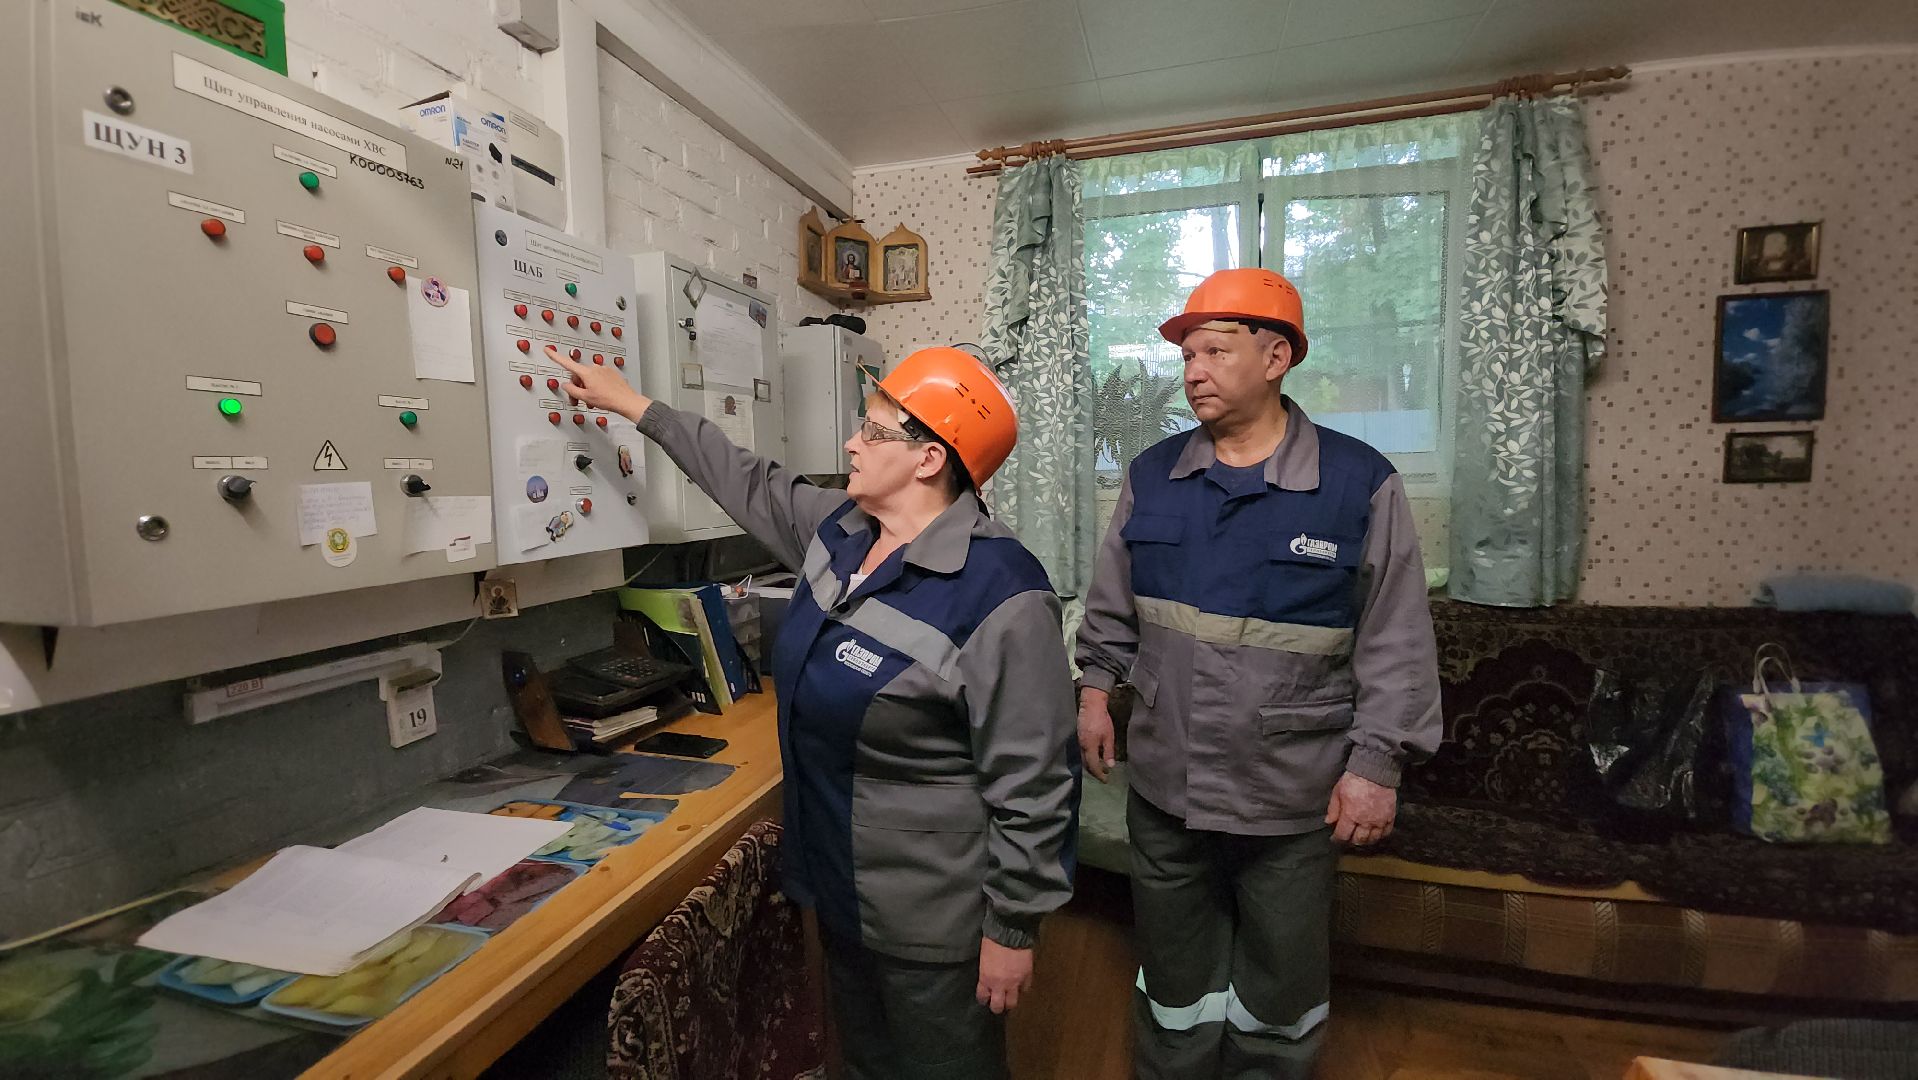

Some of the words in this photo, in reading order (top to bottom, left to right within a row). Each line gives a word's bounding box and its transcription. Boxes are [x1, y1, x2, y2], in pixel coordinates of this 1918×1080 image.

[203, 76, 234, 97] Щит
[237, 90, 308, 126] управления
[311, 120, 361, 147] насосами
[363, 138, 387, 157] ХВС
[419, 104, 446, 118] OMRON
[480, 117, 507, 134] OMRON
[94, 122, 165, 160] ЩУН
[174, 147, 187, 165] 3
[513, 259, 543, 278] ЩАБ
[1307, 538, 1338, 553] ГАЗПРОМ
[851, 644, 884, 668] ГАЗПРОМ
[409, 708, 427, 728] 19
